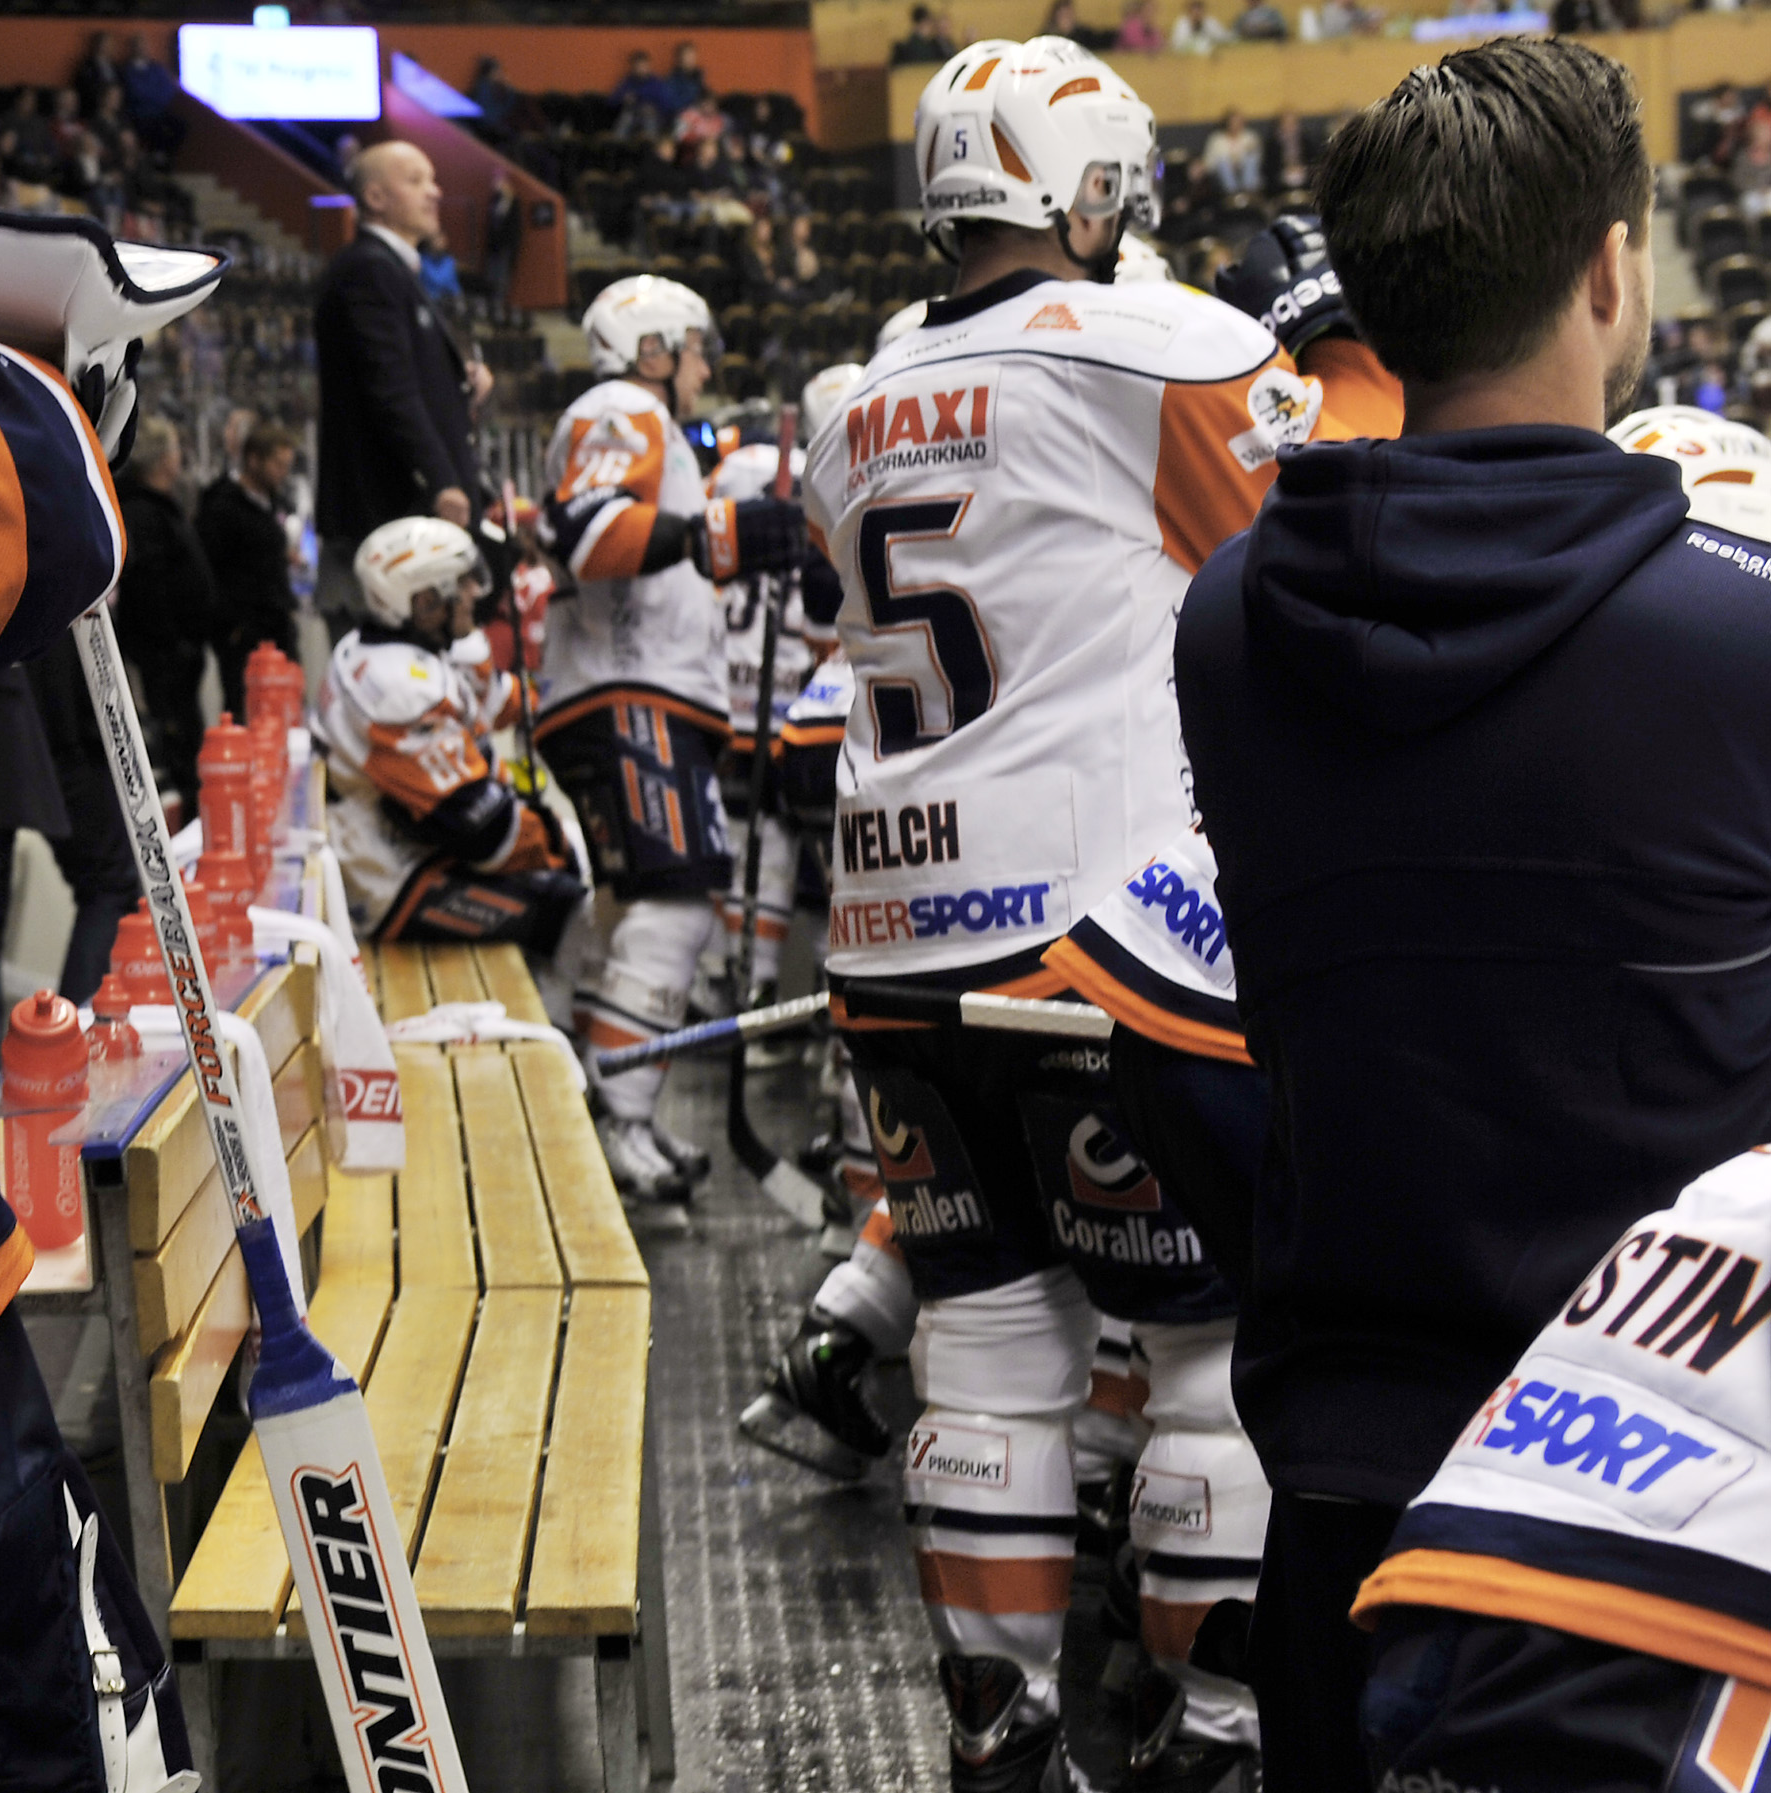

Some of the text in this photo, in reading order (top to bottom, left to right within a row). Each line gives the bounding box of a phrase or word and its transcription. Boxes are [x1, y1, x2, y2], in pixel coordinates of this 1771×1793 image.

[953, 128, 968, 160] 5
[847, 386, 989, 468] MAXI
[1687, 532, 1771, 580] Reebo
[855, 492, 999, 763] 5
[840, 801, 959, 873] WELCH
[1123, 857, 1227, 966] SPORT
[1053, 1199, 1203, 1265] Corallen
[929, 1456, 1002, 1481] PRODUKT
[1140, 1501, 1202, 1527] PRODUKT
